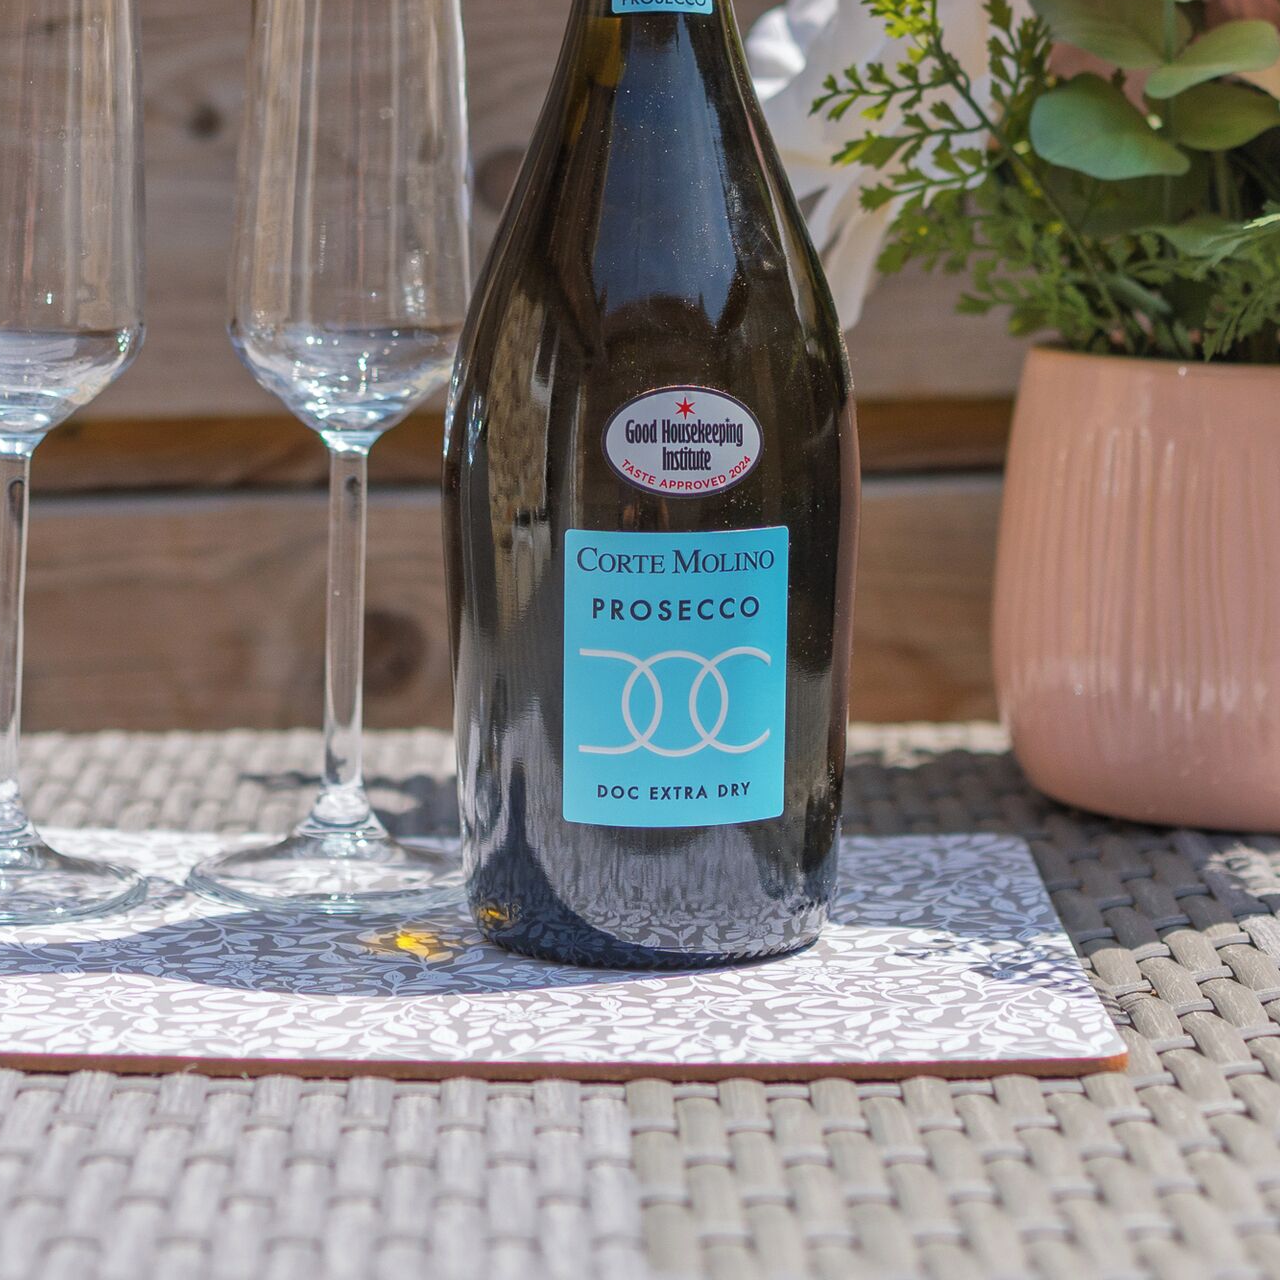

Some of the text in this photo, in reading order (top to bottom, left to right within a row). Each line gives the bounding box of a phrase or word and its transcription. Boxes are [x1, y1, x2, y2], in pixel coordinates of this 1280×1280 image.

[625, 417, 744, 447] Good Housekeeping
[662, 446, 712, 471] Institute
[621, 455, 752, 490] TASTE APPROVED 2024
[592, 595, 760, 621] PROSECCO
[597, 781, 751, 801] DOC EXTRA DRY
